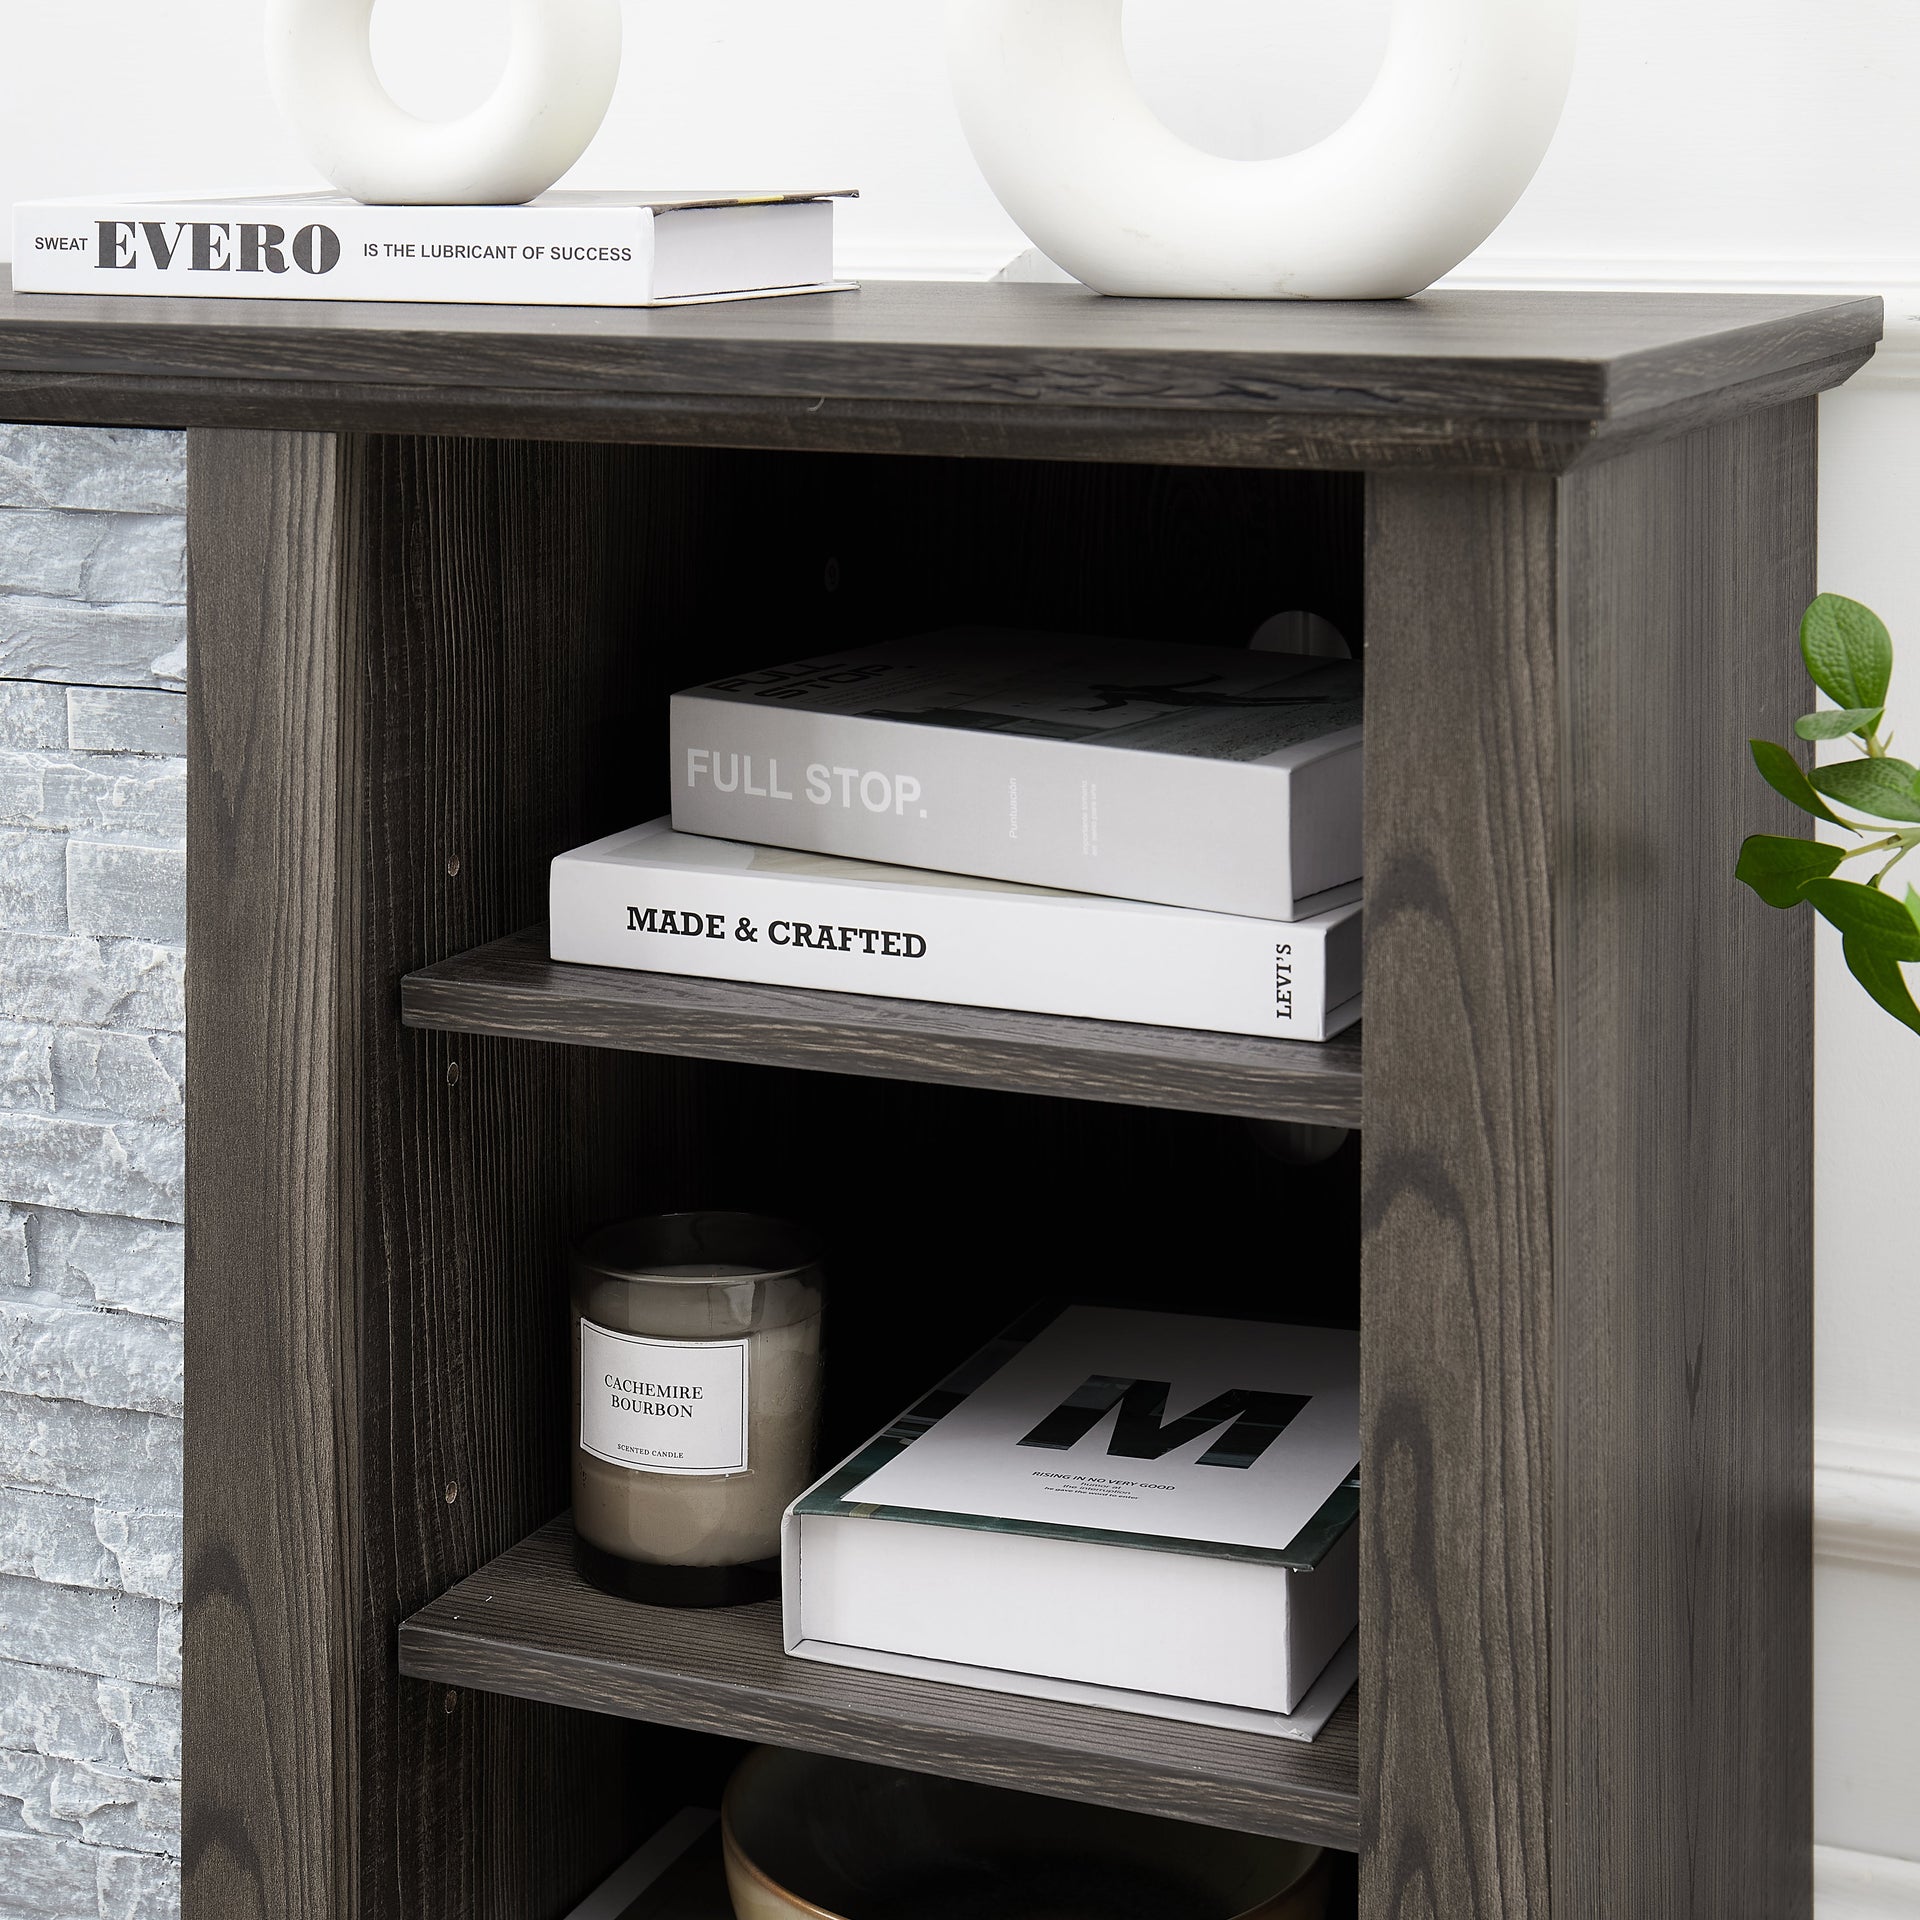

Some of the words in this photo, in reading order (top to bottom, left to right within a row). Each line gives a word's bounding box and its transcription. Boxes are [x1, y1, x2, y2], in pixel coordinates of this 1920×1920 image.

[34, 236, 88, 252] SWEAT
[94, 220, 341, 275] EVERO
[364, 243, 379, 258] IS
[383, 243, 416, 258] THE
[420, 245, 518, 261] LUBRICANT
[522, 246, 545, 261] OF
[549, 246, 632, 262] SUCCESS
[705, 664, 847, 692] FULL
[687, 748, 793, 801] FULL
[805, 763, 927, 819] STOP.
[626, 906, 727, 940] MADE
[735, 917, 758, 944] &
[767, 920, 928, 960] CRAFTED
[1275, 942, 1293, 1020] LEVI'S
[604, 1374, 703, 1399] CACHEMIRE
[611, 1394, 694, 1418] BOURBON
[1016, 1374, 1314, 1470] M
[617, 1443, 650, 1456] SCENTED
[651, 1449, 684, 1459] CANDLE
[1032, 1471, 1071, 1480] RISING
[1109, 1479, 1138, 1487] VERY
[1139, 1483, 1176, 1491] GOOD
